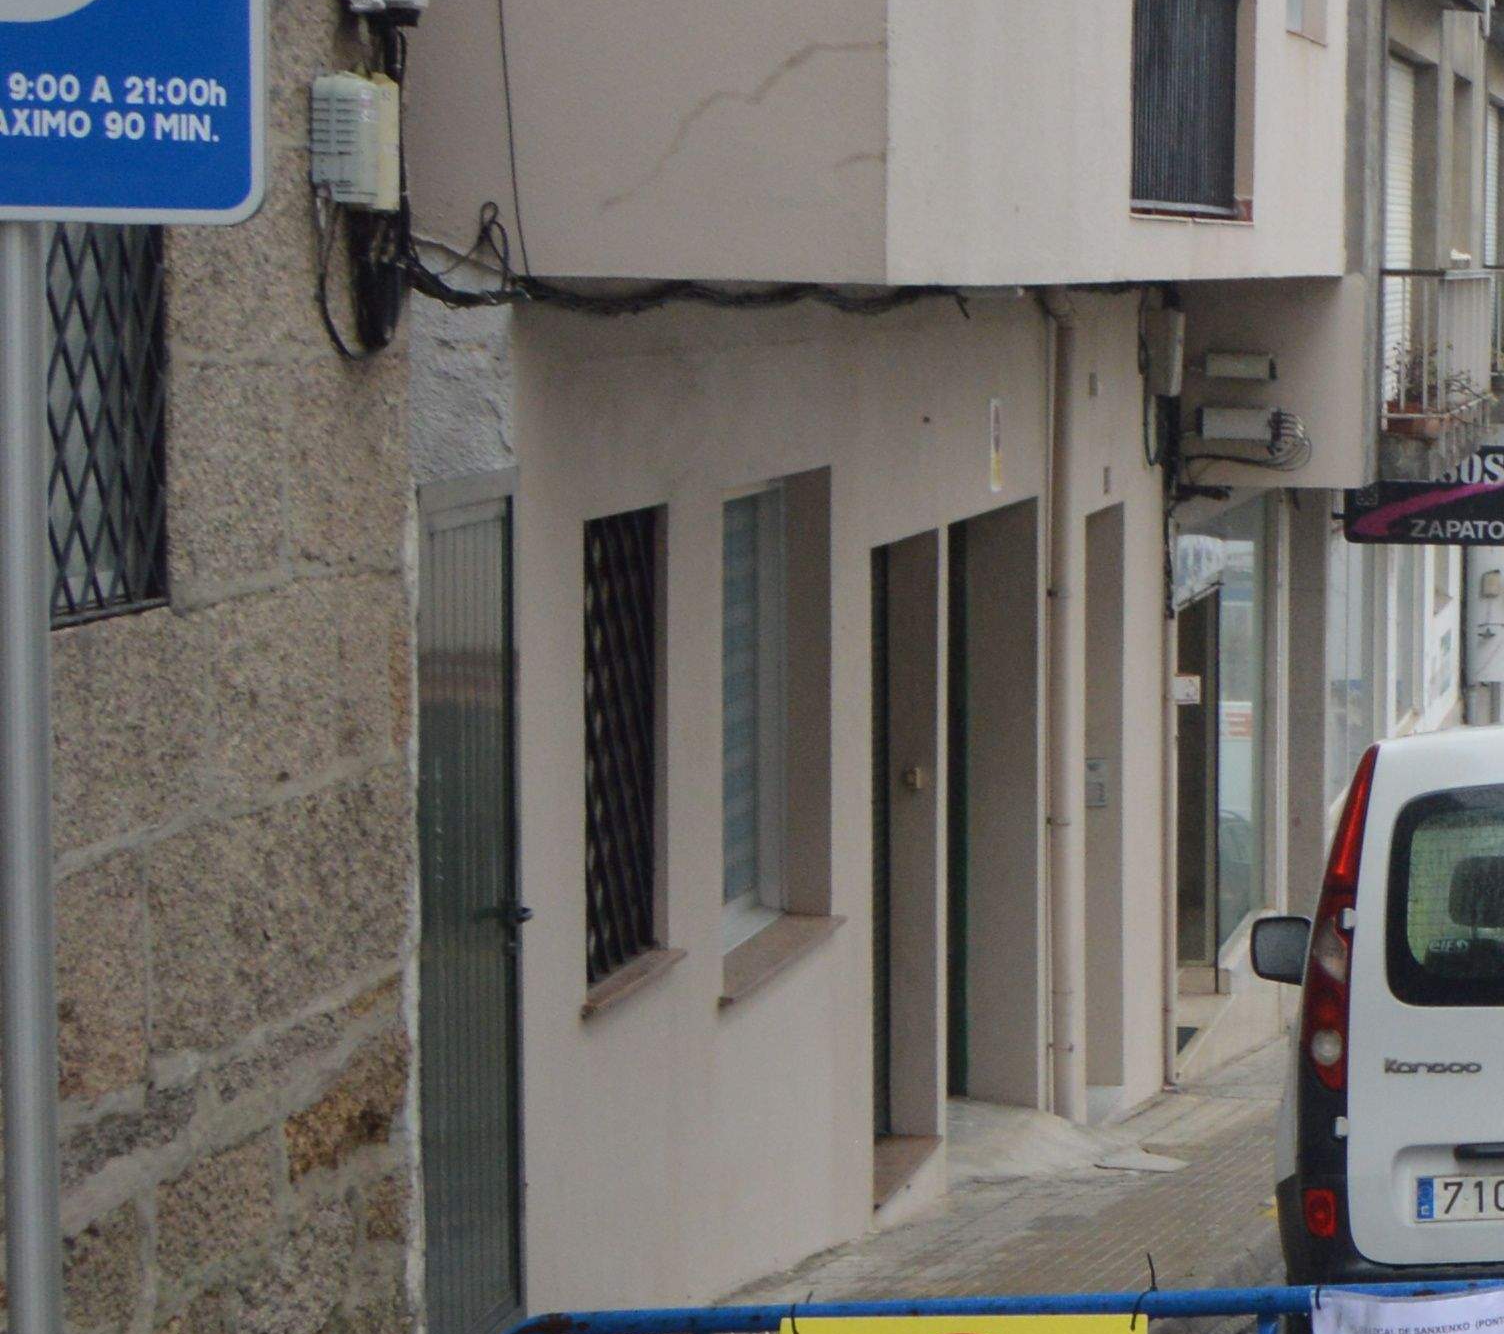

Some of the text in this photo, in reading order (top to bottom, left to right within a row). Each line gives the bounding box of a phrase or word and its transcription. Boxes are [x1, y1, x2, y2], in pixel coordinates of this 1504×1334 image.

[9, 71, 227, 107] 9:00 A 21:00h
[104, 110, 146, 141] 90
[154, 111, 220, 142] MIN.
